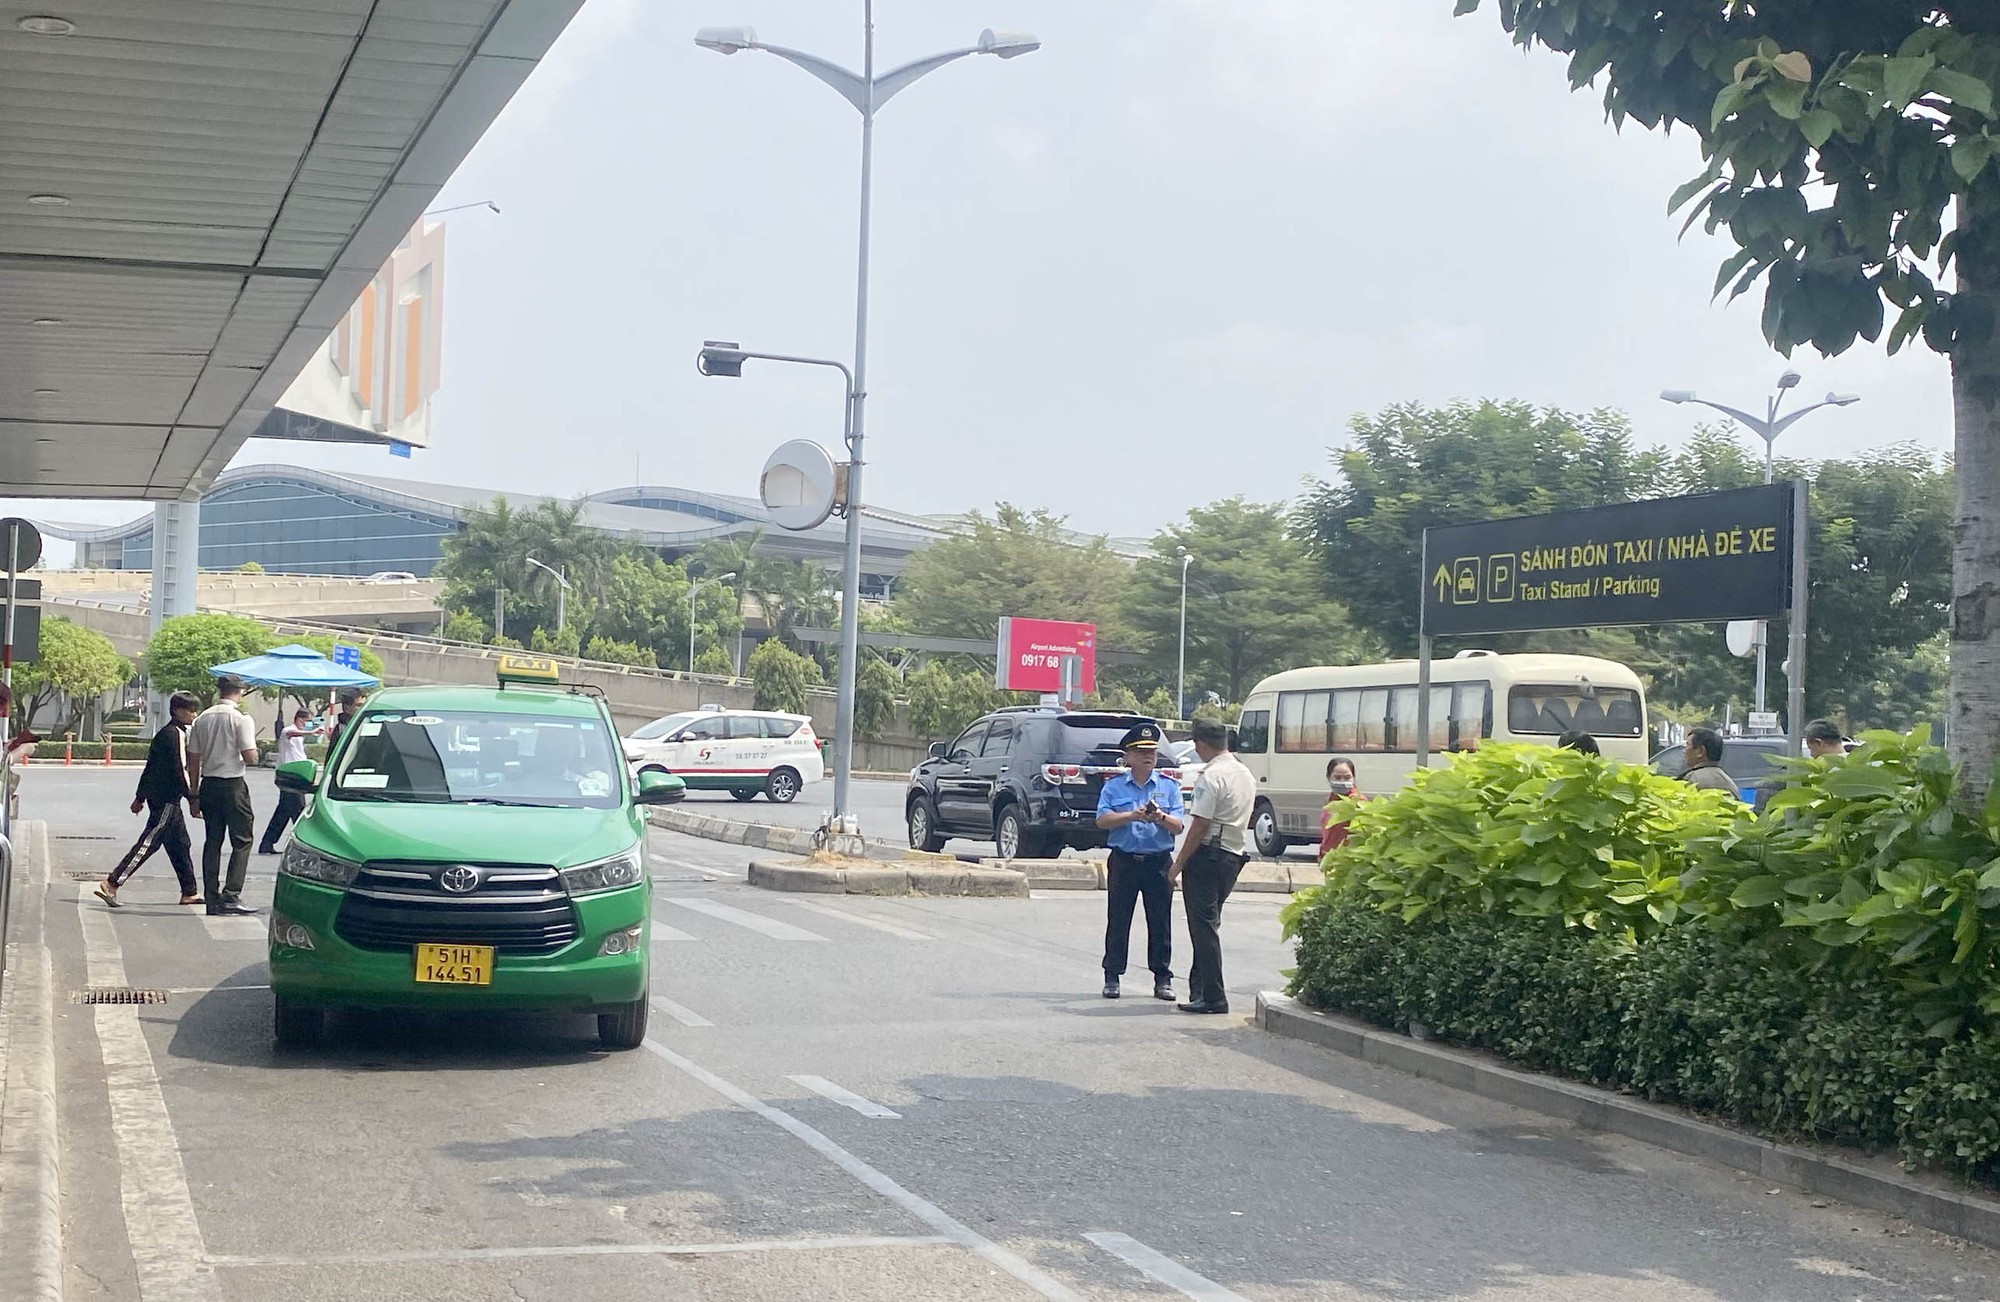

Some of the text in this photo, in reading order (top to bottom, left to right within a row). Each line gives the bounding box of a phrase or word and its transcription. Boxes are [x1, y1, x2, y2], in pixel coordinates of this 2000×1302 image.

[1520, 545, 1566, 572] SẢNH
[1570, 539, 1608, 568] ĐÓN
[1613, 538, 1653, 564] TAXI
[1657, 537, 1665, 560] /
[1668, 528, 1710, 560] NHÀ
[1748, 526, 1776, 554] XE
[1520, 574, 1660, 601] Taxi Stand / Parking
[1030, 643, 1049, 653] Airport
[1021, 654, 1059, 668] 0917 68
[439, 948, 471, 964] 51H
[427, 965, 481, 982] 144.51
